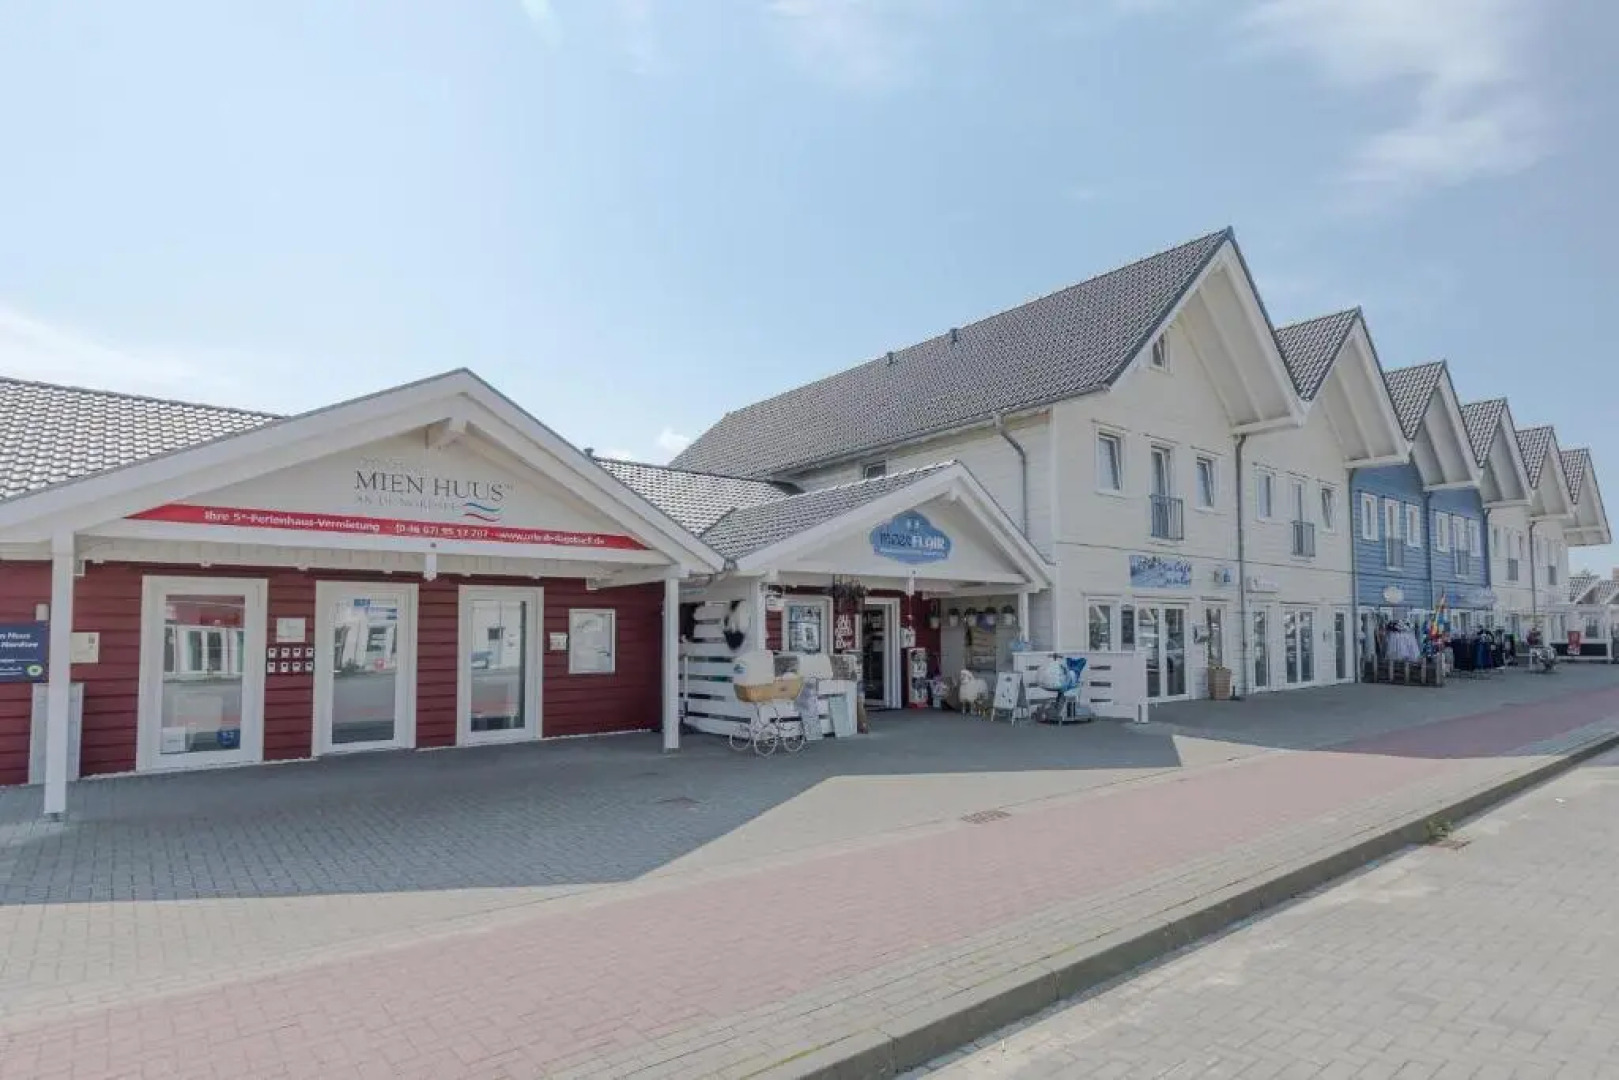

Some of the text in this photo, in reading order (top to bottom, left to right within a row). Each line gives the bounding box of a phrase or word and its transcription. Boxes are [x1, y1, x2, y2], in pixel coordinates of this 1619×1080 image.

[354, 470, 504, 501] MIEN HUUS
[204, 511, 230, 521] Ihre
